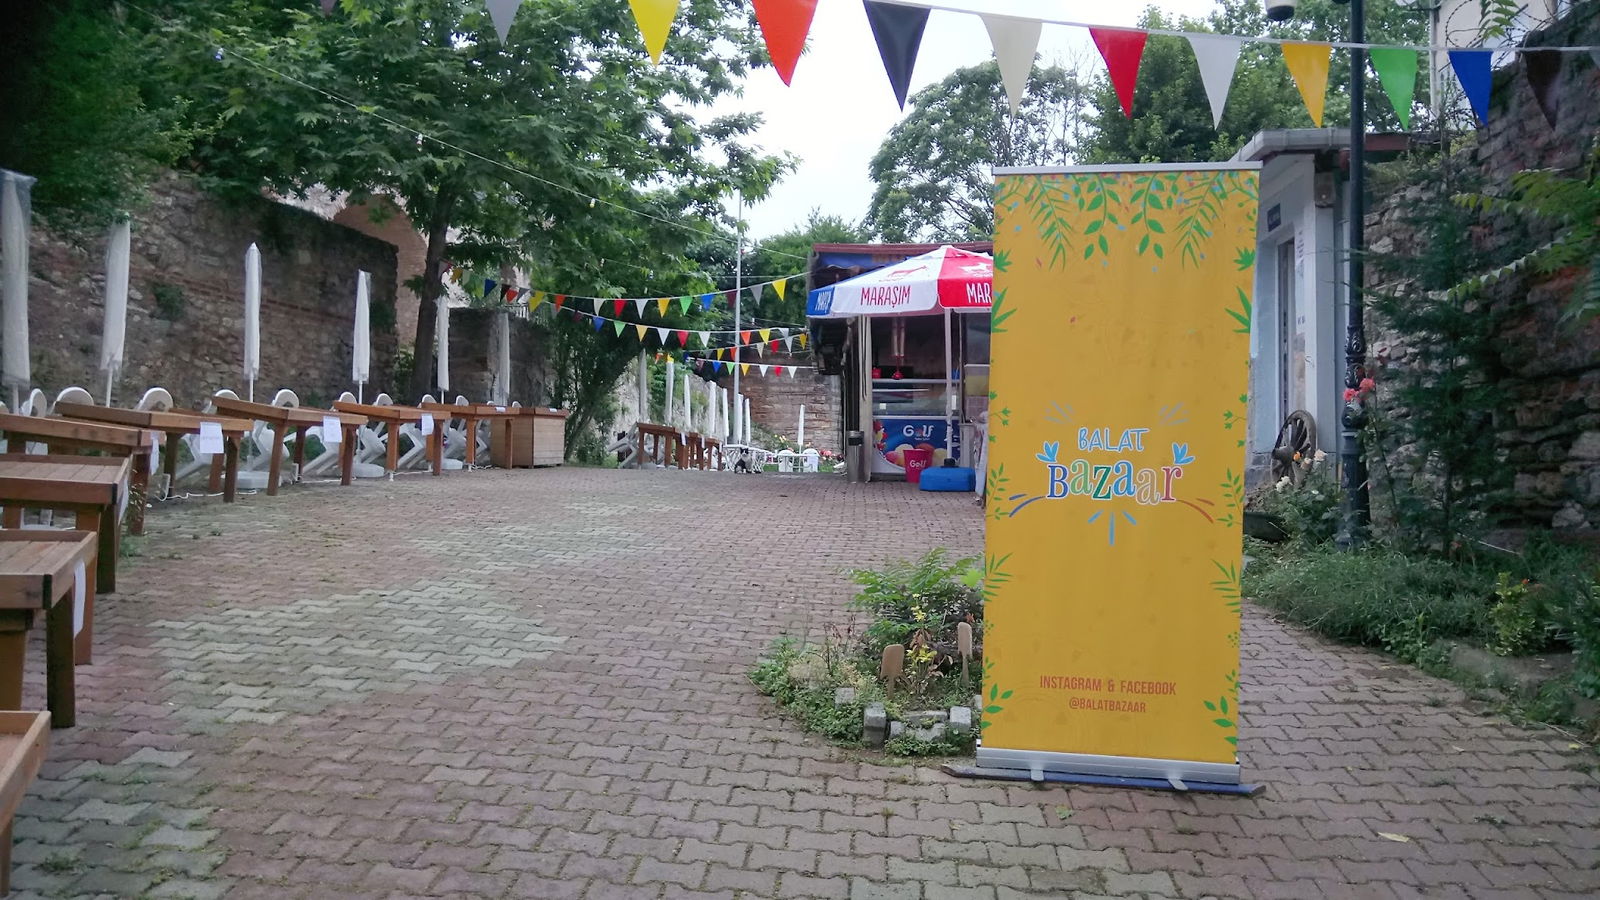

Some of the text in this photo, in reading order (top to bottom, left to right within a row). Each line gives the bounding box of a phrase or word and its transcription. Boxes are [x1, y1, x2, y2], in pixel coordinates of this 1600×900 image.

[860, 285, 911, 308] MARAŞIM
[1077, 427, 1150, 452] BALAT
[1046, 458, 1183, 505] Bazaar
[1040, 675, 1177, 695] INSTAGRAM & FACEBOOK
[1069, 696, 1146, 713] @BALATBAZAAR
